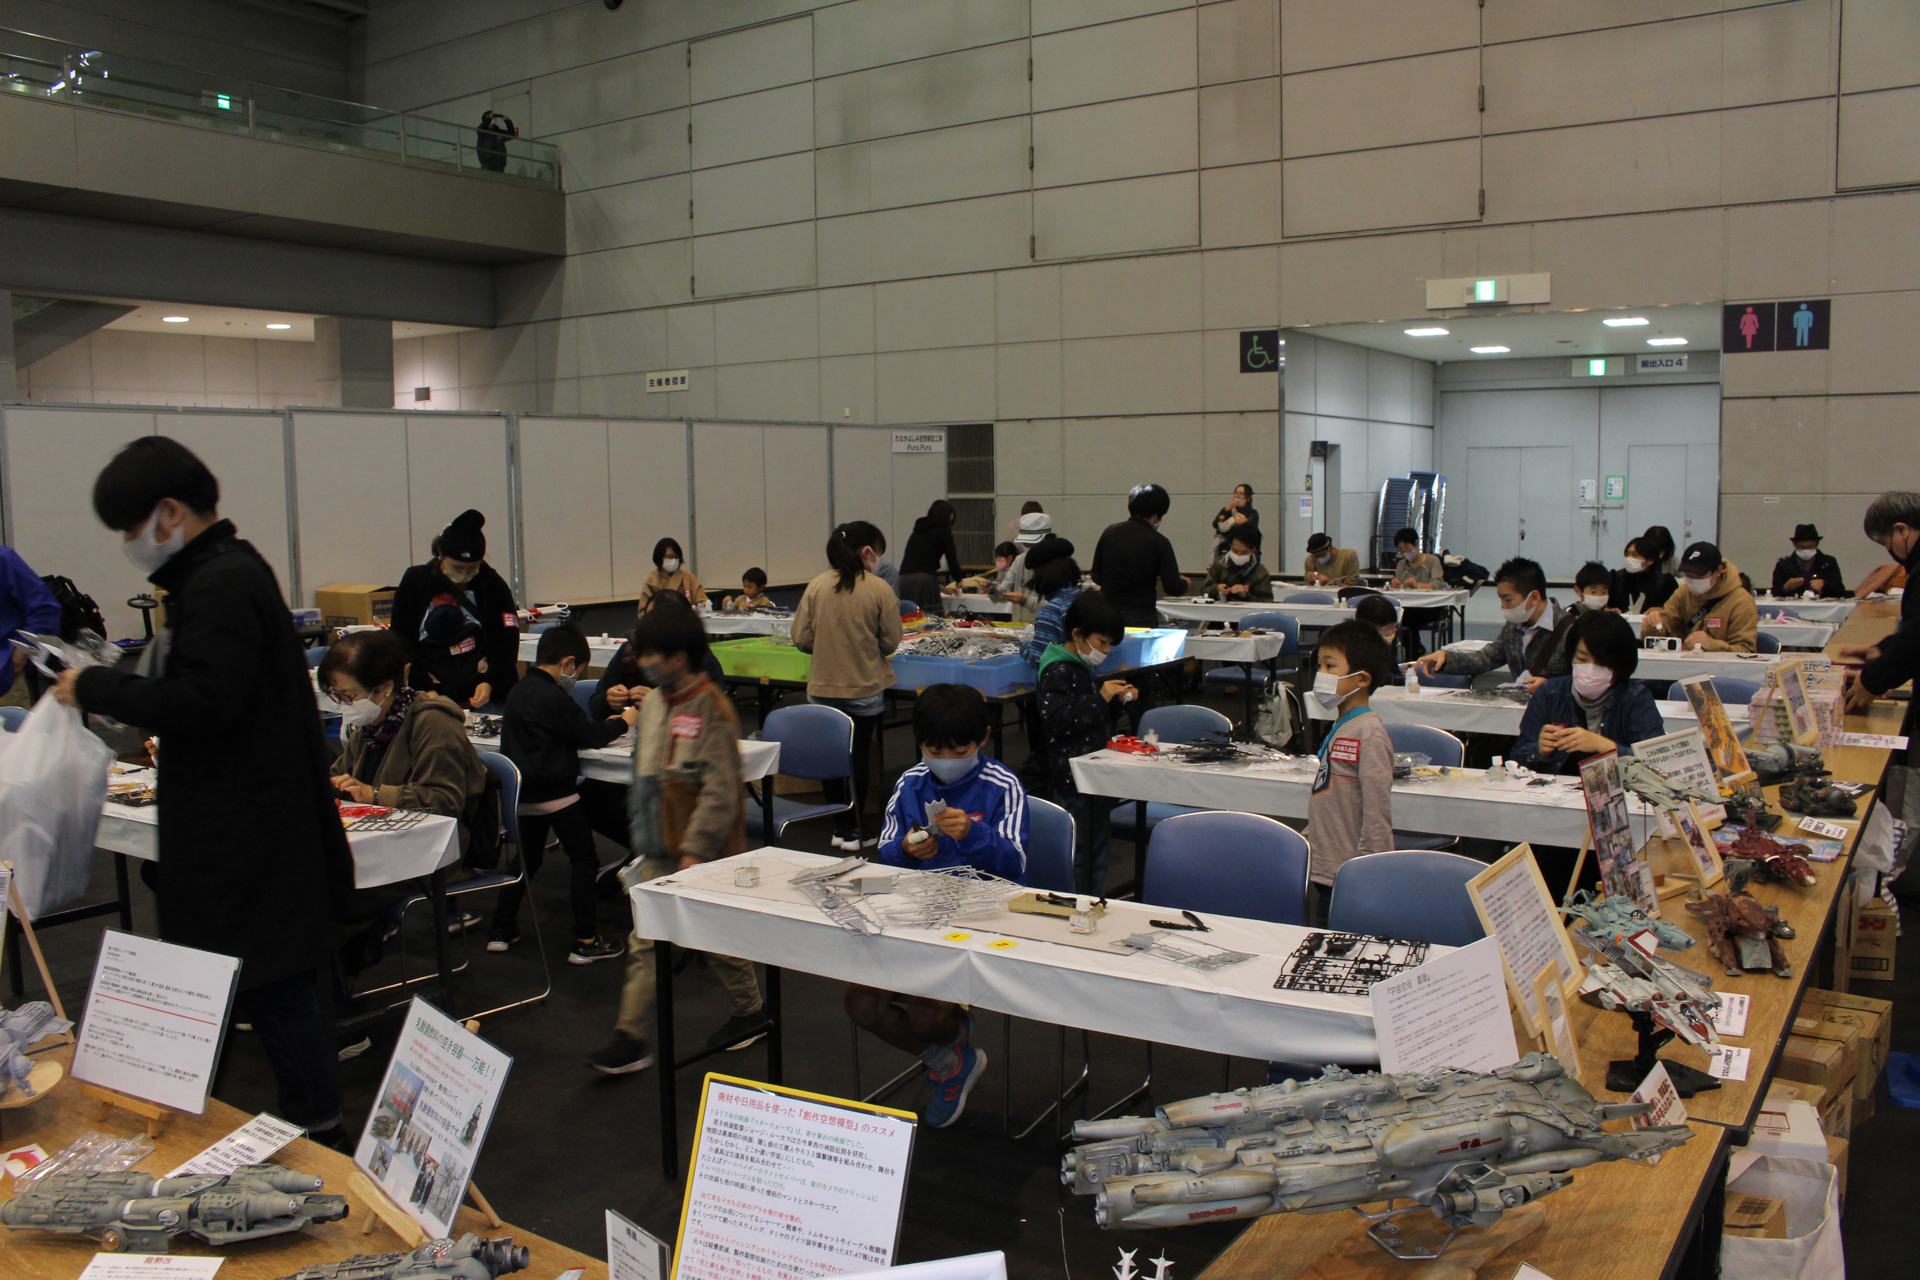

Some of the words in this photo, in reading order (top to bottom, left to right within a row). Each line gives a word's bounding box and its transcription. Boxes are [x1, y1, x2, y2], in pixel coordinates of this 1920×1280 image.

[716, 1091, 895, 1138] 廃材や日用品を使った『創作空想模型』のススメ
[689, 1217, 704, 1228] です。
